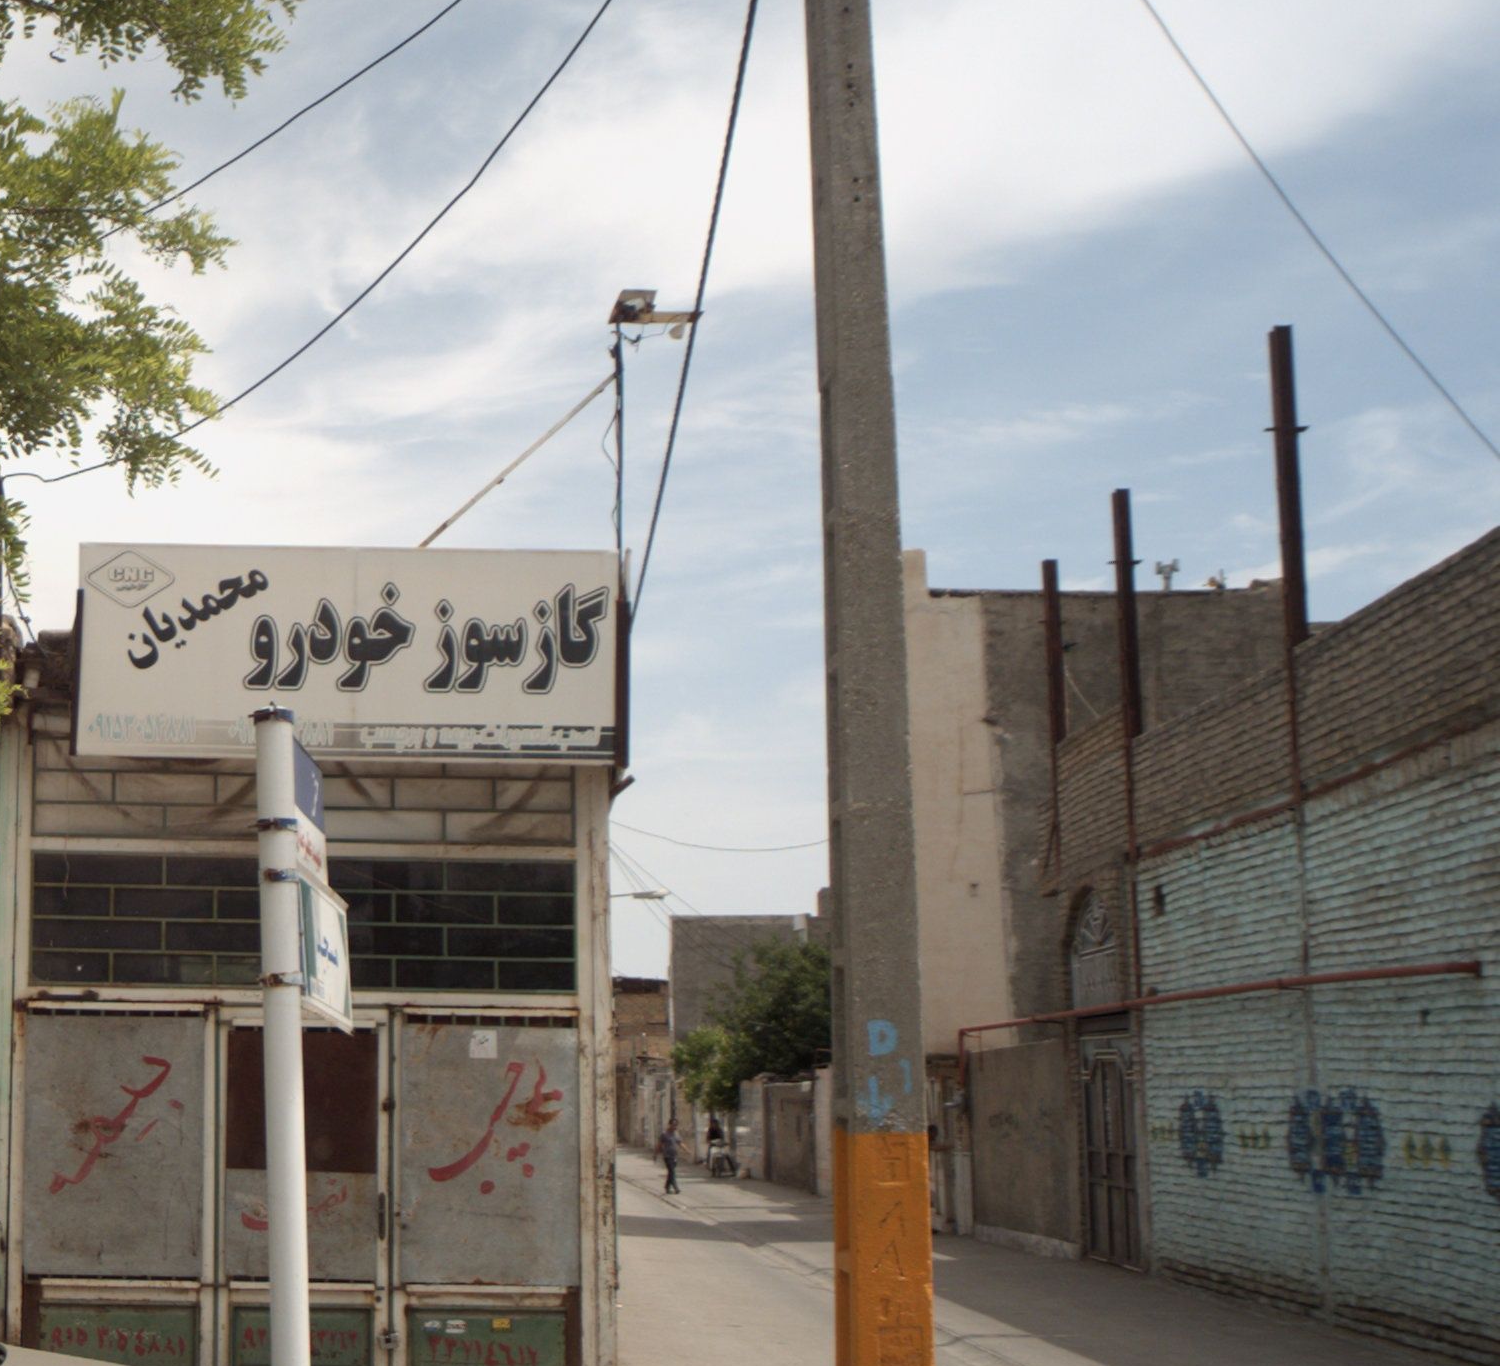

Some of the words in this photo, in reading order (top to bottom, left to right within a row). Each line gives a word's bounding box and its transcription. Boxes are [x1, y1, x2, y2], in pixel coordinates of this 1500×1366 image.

[108, 566, 155, 583] CNG
[126, 567, 270, 670] محمدیان
[243, 582, 416, 693] خودرو
